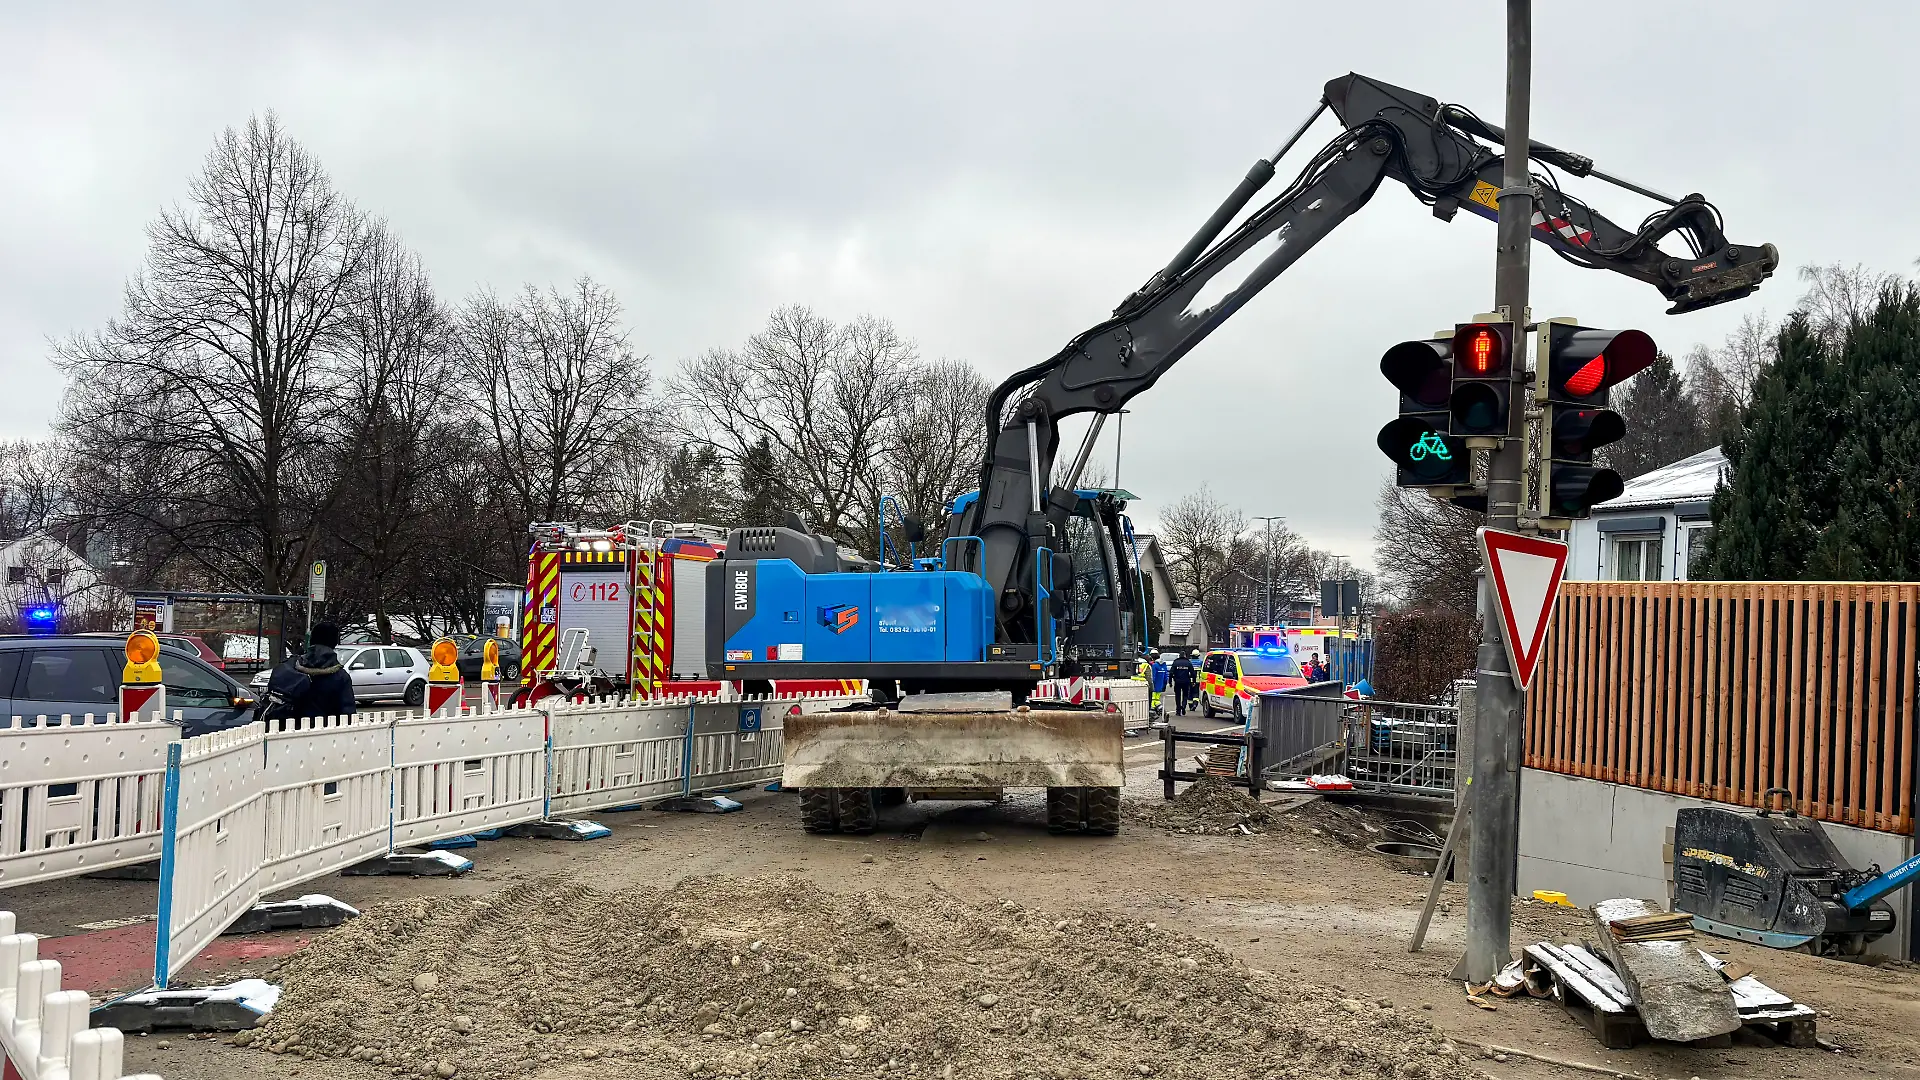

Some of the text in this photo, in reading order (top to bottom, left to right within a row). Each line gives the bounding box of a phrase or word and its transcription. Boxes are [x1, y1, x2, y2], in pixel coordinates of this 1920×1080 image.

[589, 582, 620, 601] 112
[734, 570, 748, 610] EW180E
[1887, 865, 1909, 880] HUBERT
[1795, 904, 1808, 915] 69
